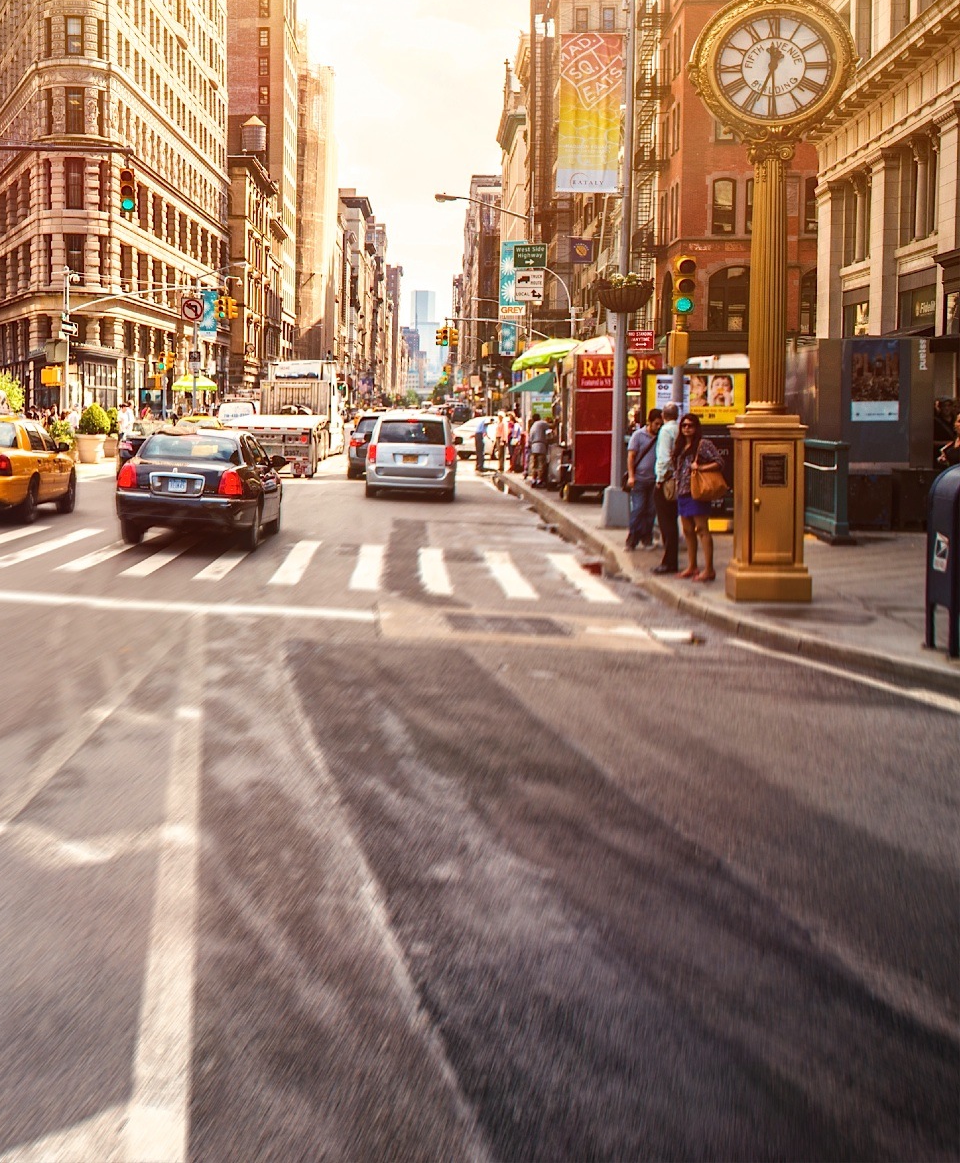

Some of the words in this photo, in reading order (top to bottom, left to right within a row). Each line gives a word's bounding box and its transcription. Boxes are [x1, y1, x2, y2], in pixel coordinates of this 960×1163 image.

[559, 37, 597, 68] MAD.
[744, 44, 765, 69] FIFTH
[568, 59, 600, 80] SQ.
[582, 66, 623, 103] EATS
[750, 77, 799, 95] BUILDING
[517, 252, 543, 260] Highway
[501, 306, 524, 314] GREY
